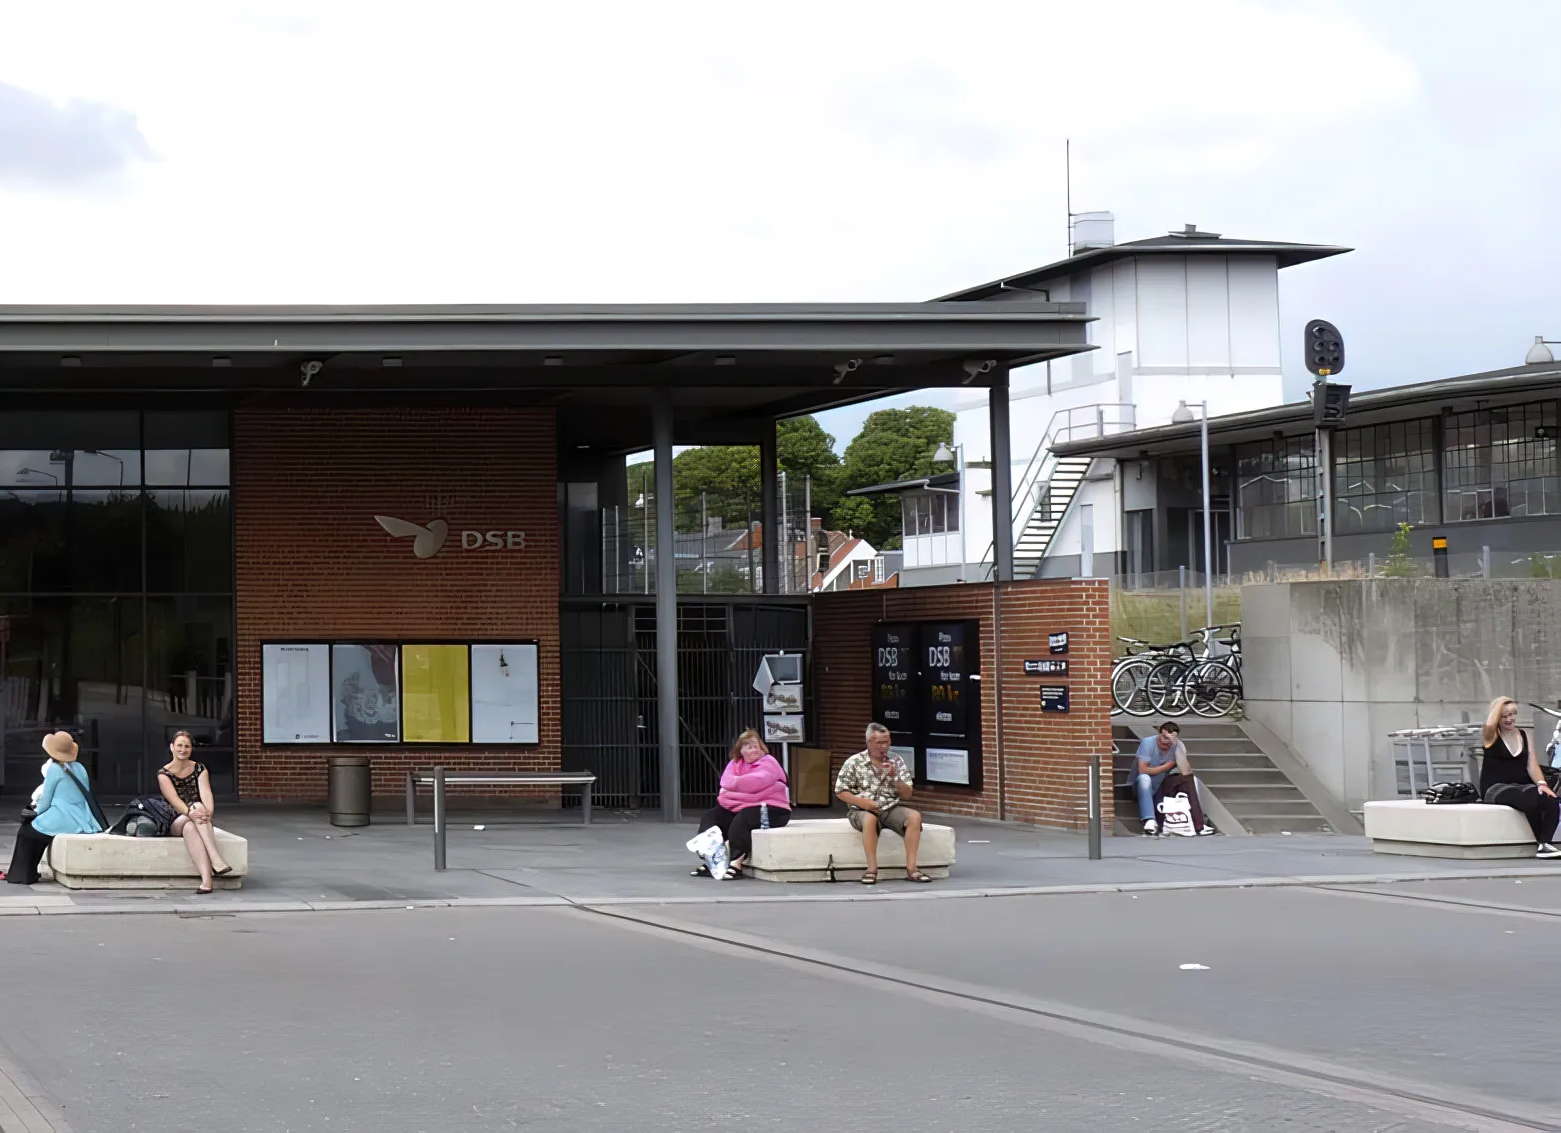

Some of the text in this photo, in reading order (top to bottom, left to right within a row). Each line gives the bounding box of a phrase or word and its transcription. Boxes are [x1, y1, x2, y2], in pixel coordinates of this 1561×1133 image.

[461, 530, 526, 550] DSB
[878, 647, 898, 667] DSB
[929, 646, 950, 667] DSB
